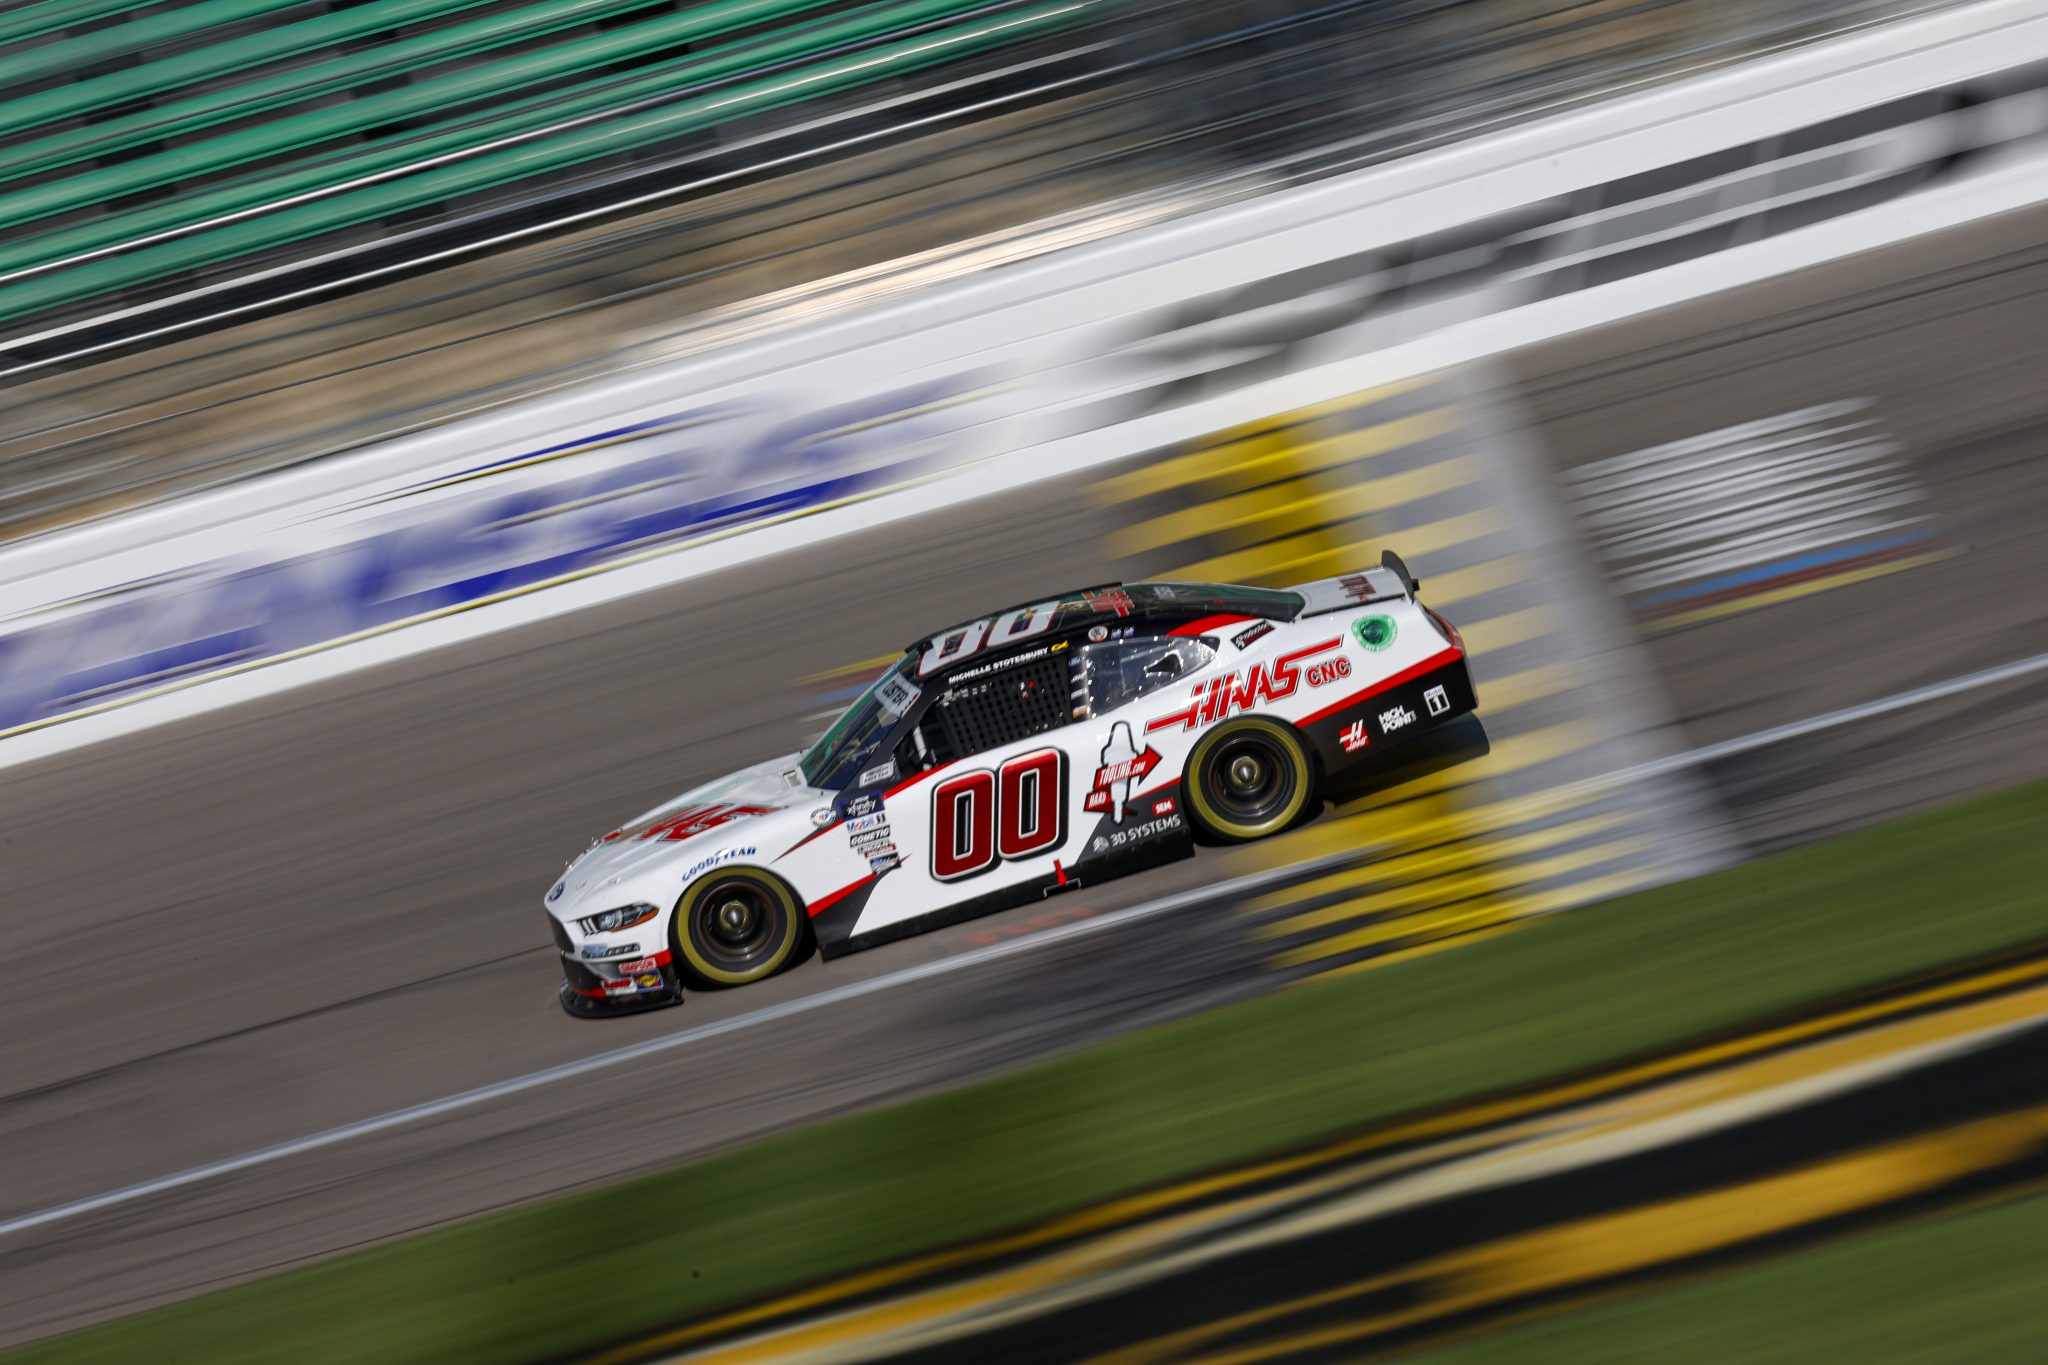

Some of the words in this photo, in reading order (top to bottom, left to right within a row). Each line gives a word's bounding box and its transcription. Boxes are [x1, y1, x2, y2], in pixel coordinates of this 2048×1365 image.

[948, 663, 992, 685] MICHELLE
[992, 646, 1049, 670] STOTESBURY
[1143, 634, 1344, 737] HAAS
[1305, 655, 1352, 687] CNC
[1378, 705, 1405, 724] HIGH
[931, 746, 1069, 883] 00
[1110, 831, 1127, 847] 3D
[1127, 814, 1181, 841] SYSTEMS
